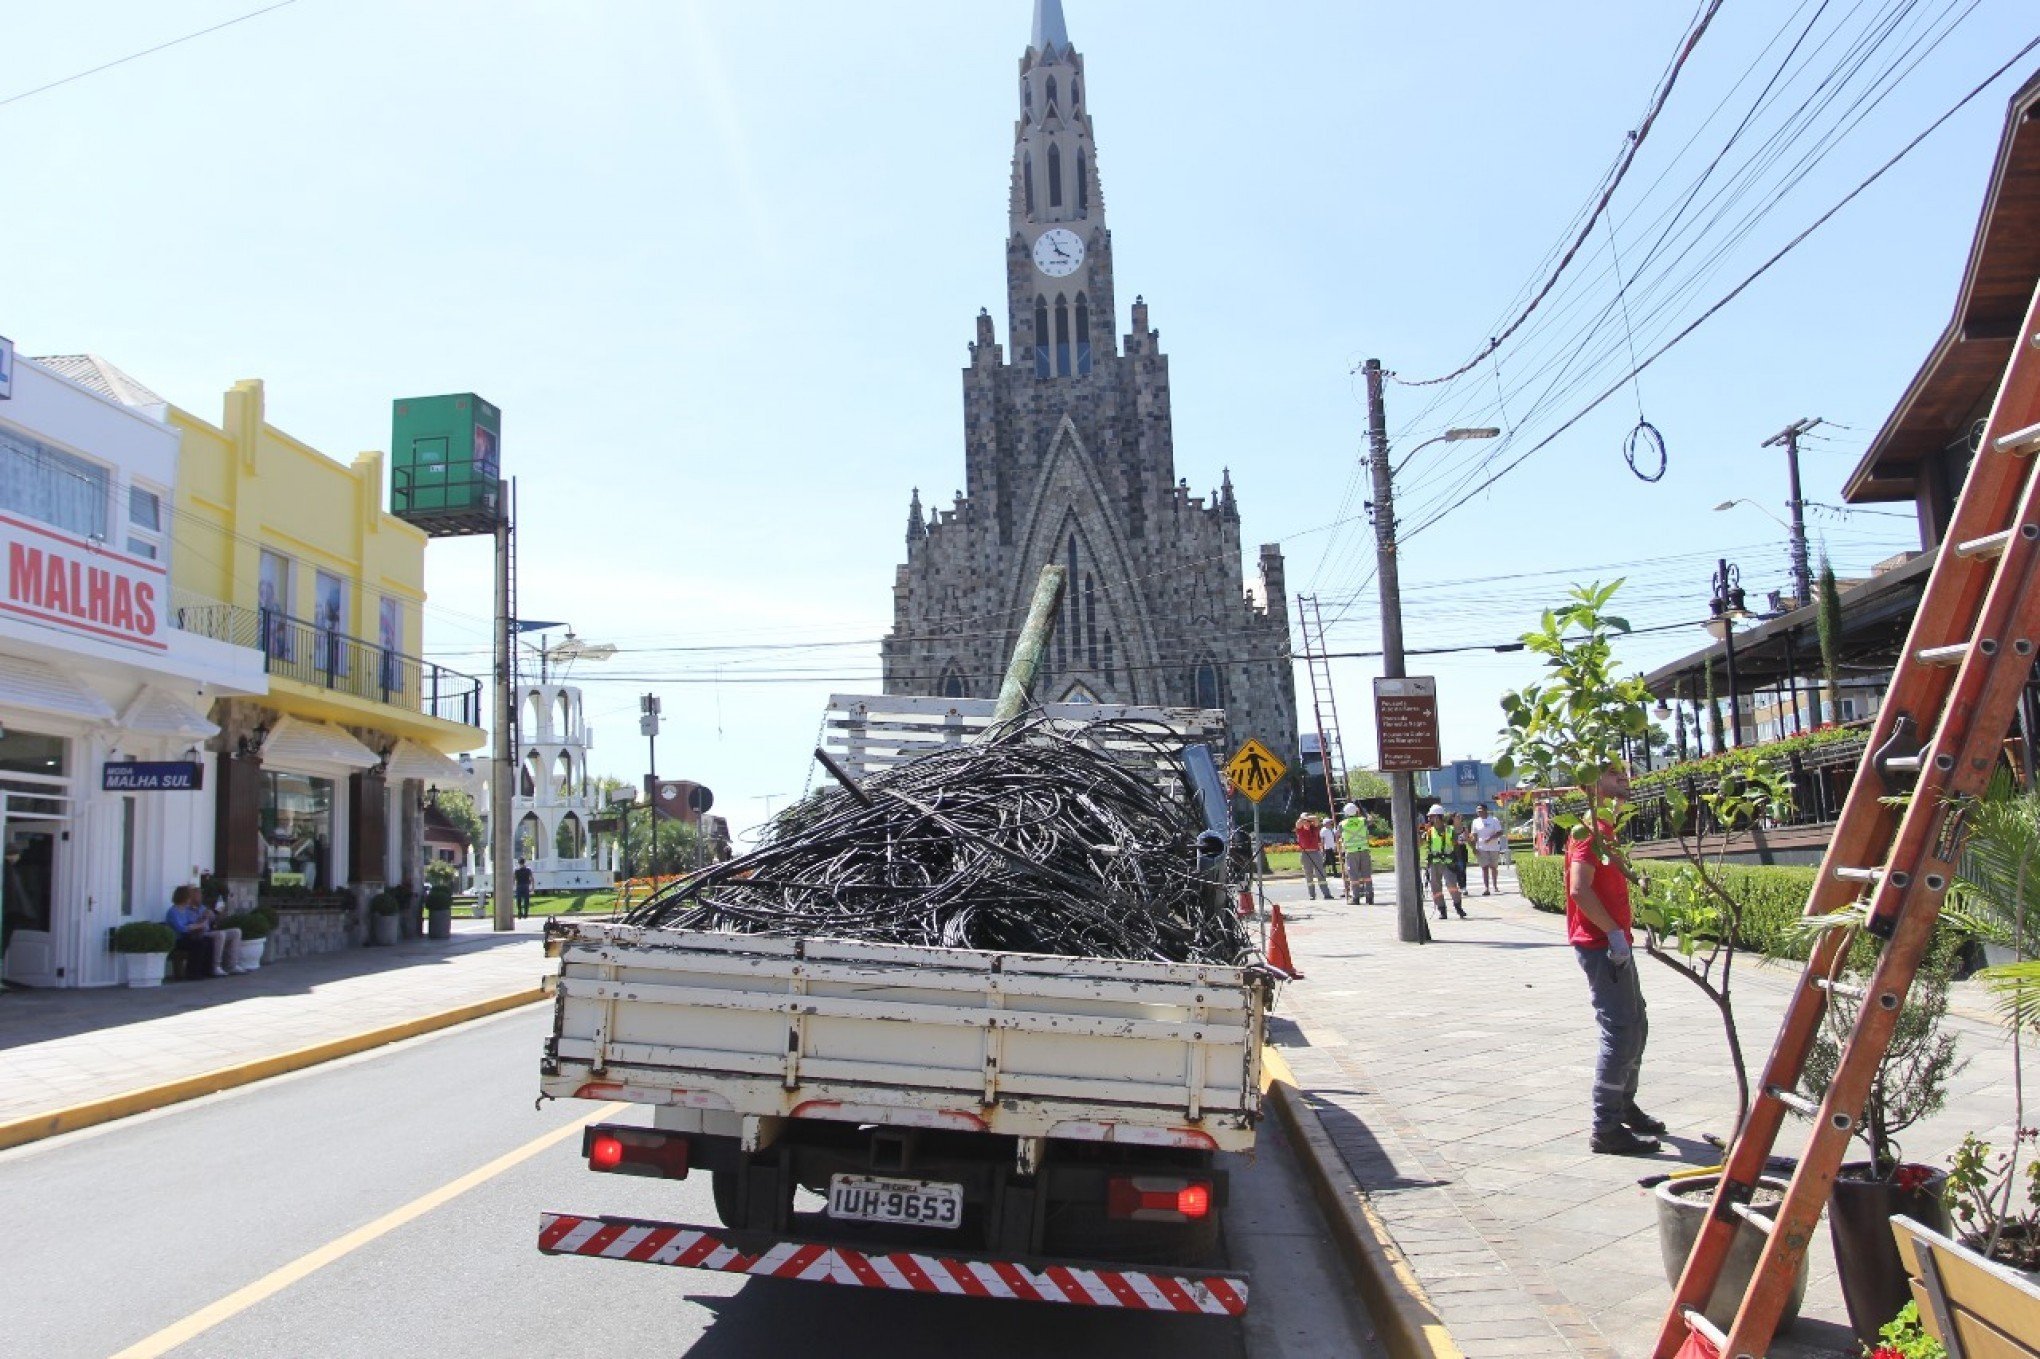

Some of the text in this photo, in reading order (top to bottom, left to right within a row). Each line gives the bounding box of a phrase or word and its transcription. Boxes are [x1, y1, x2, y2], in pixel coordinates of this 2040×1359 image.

[9, 541, 156, 636] MALHAS
[106, 775, 191, 788] MALHA SUL
